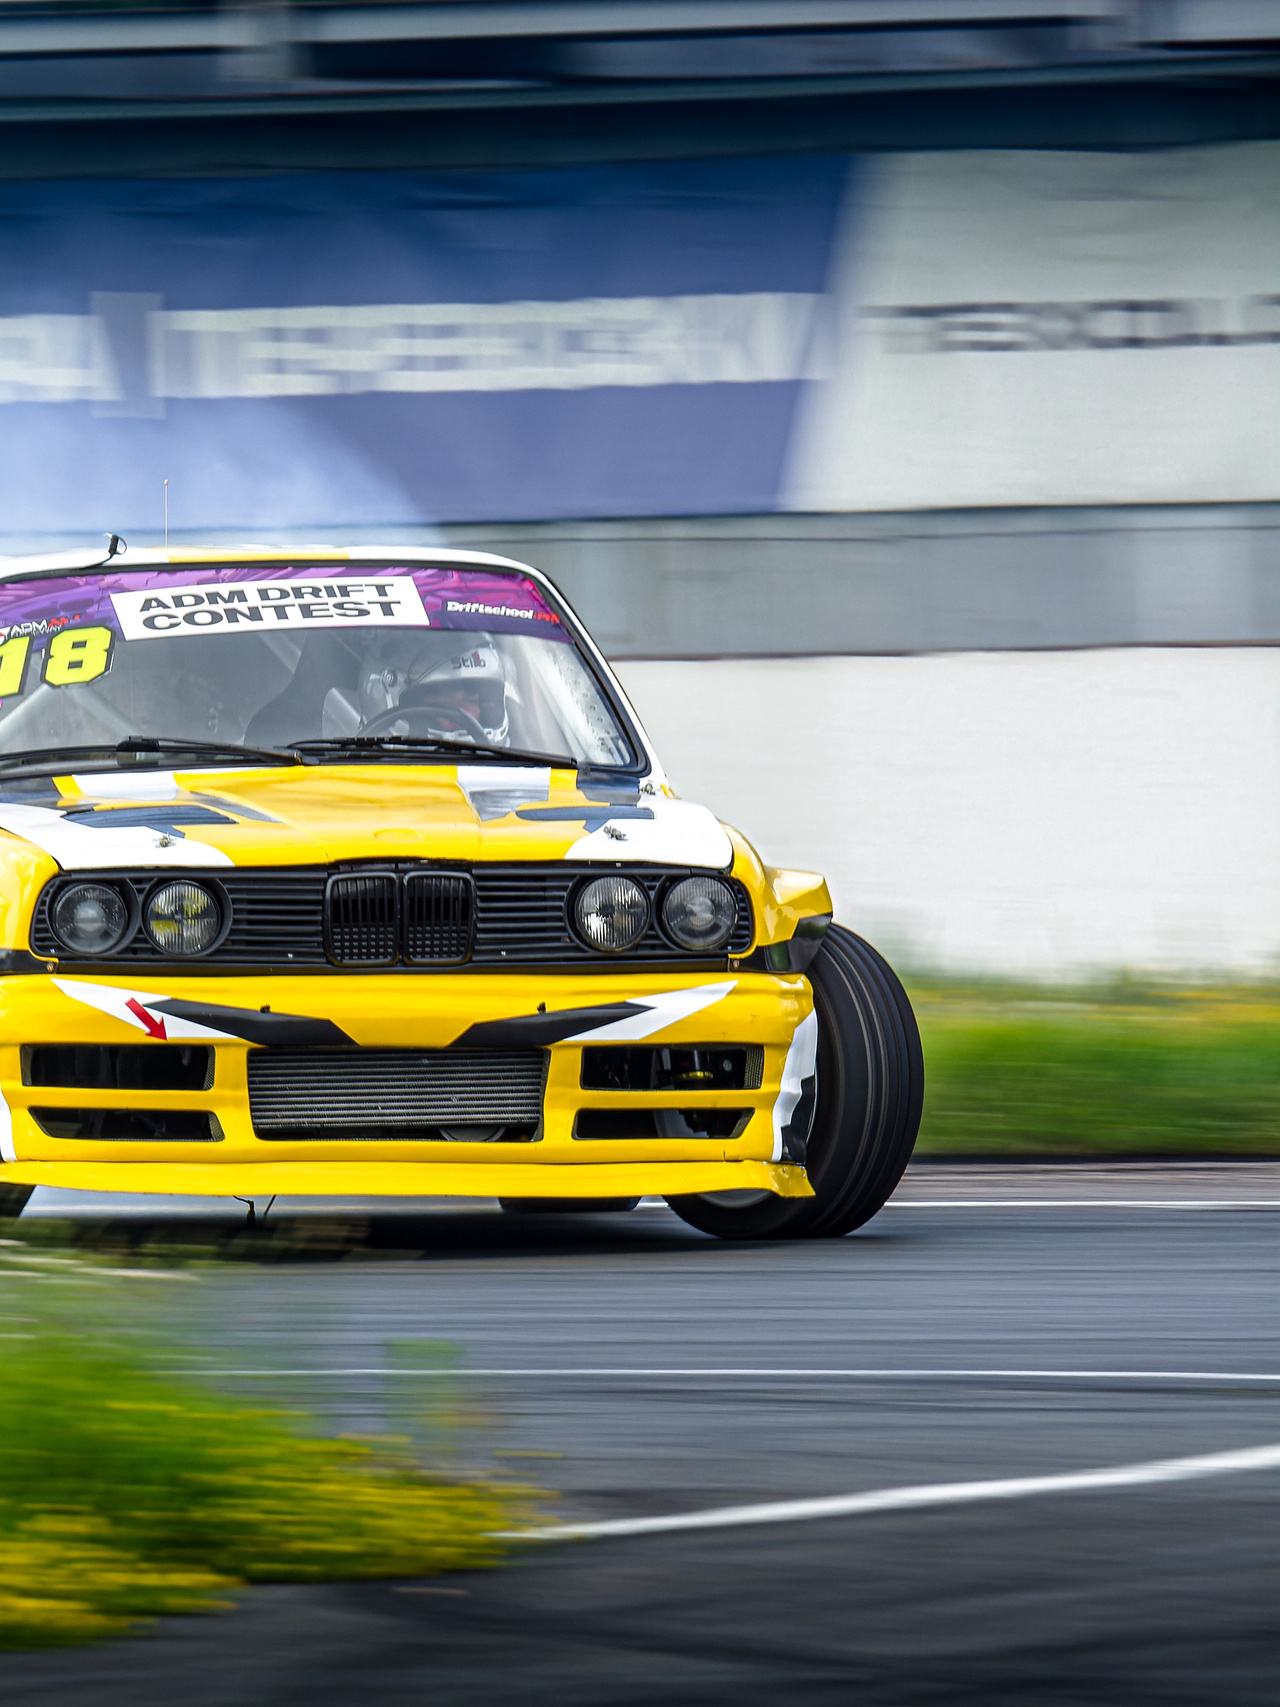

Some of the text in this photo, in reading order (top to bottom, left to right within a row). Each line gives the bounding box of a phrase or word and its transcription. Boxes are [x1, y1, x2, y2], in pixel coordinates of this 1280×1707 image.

[139, 583, 394, 613] ADM DRIFT
[142, 601, 402, 630] CONTEST
